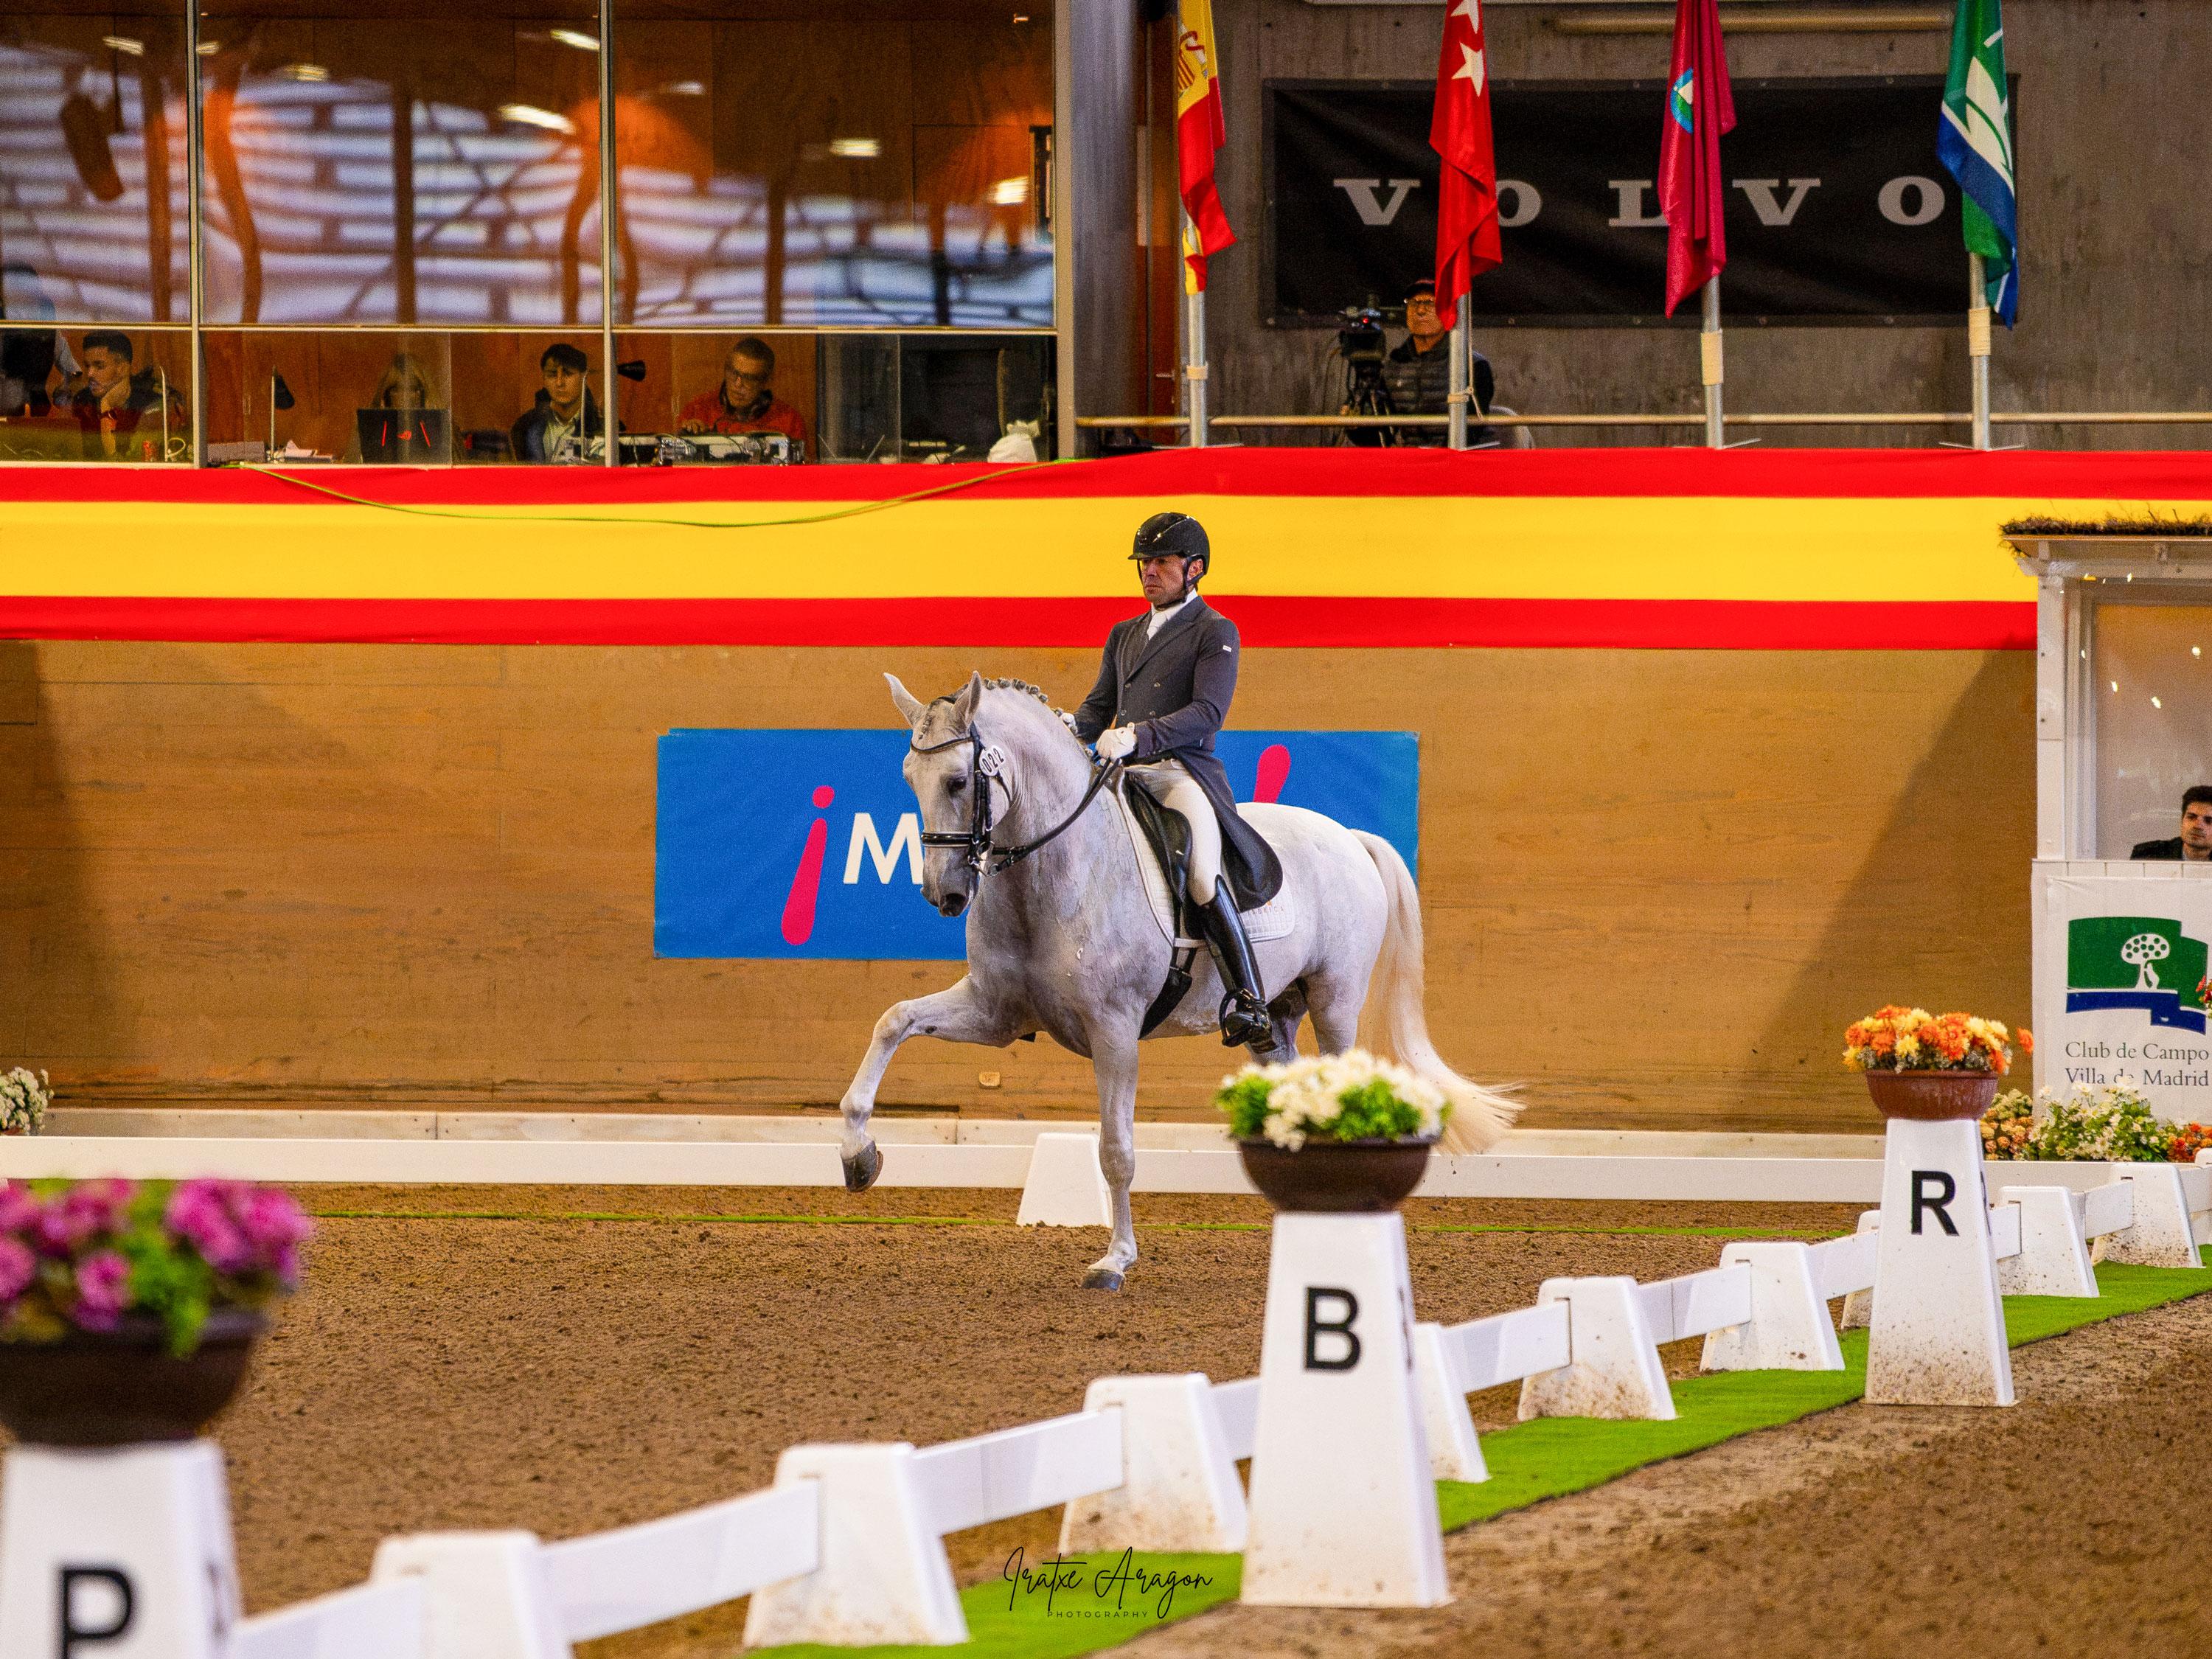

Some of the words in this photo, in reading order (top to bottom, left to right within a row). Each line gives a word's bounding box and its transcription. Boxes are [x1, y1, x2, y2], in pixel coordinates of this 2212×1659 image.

[1333, 175, 1945, 226] VOLVO
[2065, 1041, 2110, 1059] Club
[2116, 1042, 2137, 1059] de
[2143, 1043, 2209, 1065] Campo
[2065, 1068, 2105, 1084] Villa
[2113, 1068, 2135, 1084] d
[2143, 1069, 2209, 1087] Madrid
[1911, 1169, 1960, 1237] R
[1304, 1286, 1361, 1371] B
[58, 1565, 136, 1659] P
